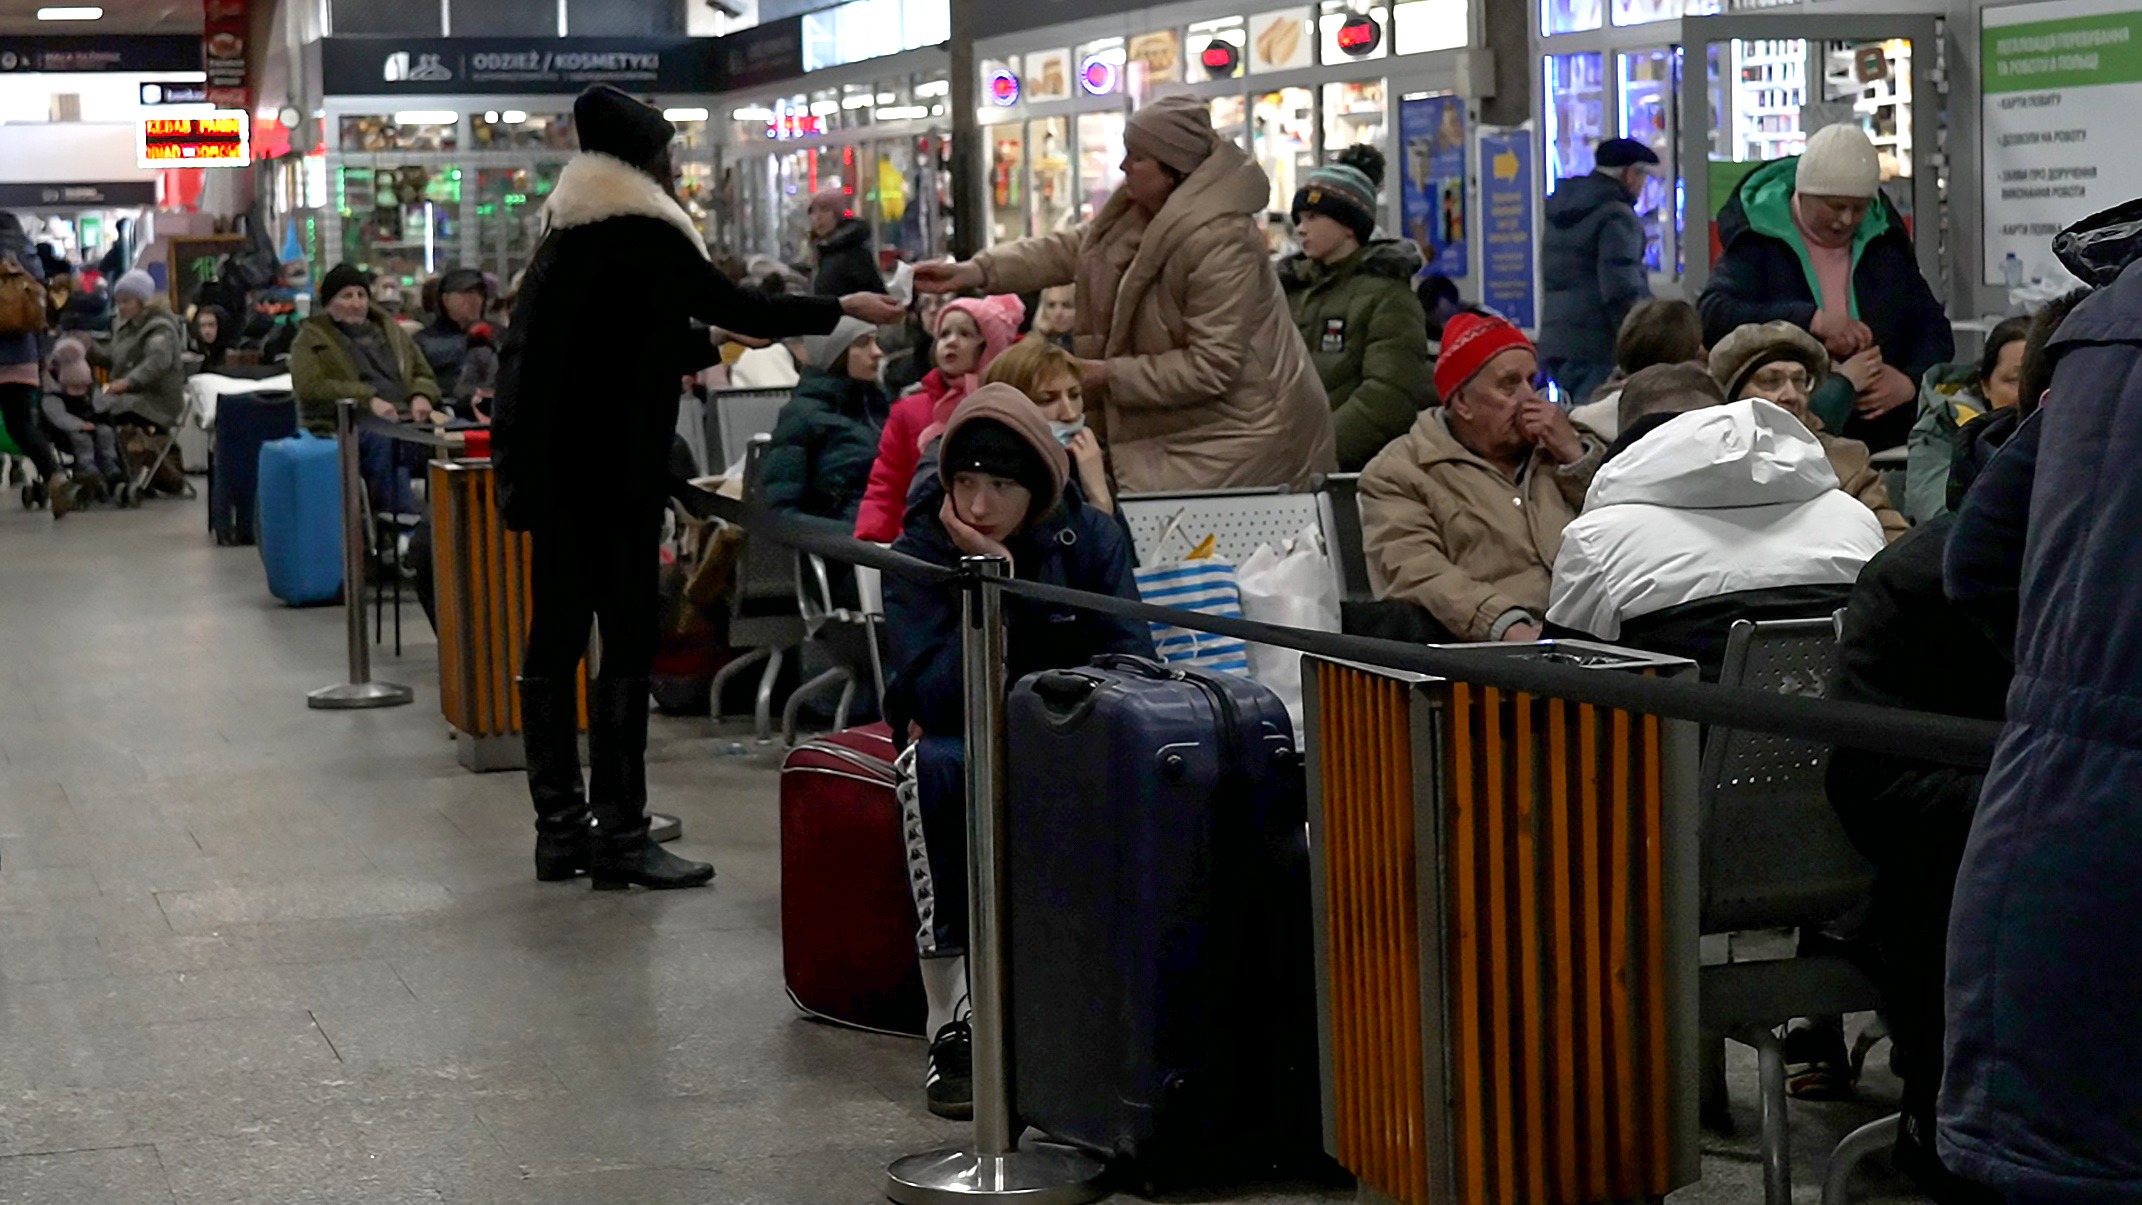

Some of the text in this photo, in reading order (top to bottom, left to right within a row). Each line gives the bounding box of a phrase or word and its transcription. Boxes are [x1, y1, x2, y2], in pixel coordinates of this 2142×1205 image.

[473, 49, 539, 70] ODZIEŻ
[556, 53, 660, 70] KOSMETYKI
[2041, 131, 2052, 142] НА
[2028, 168, 2046, 181] ПРО
